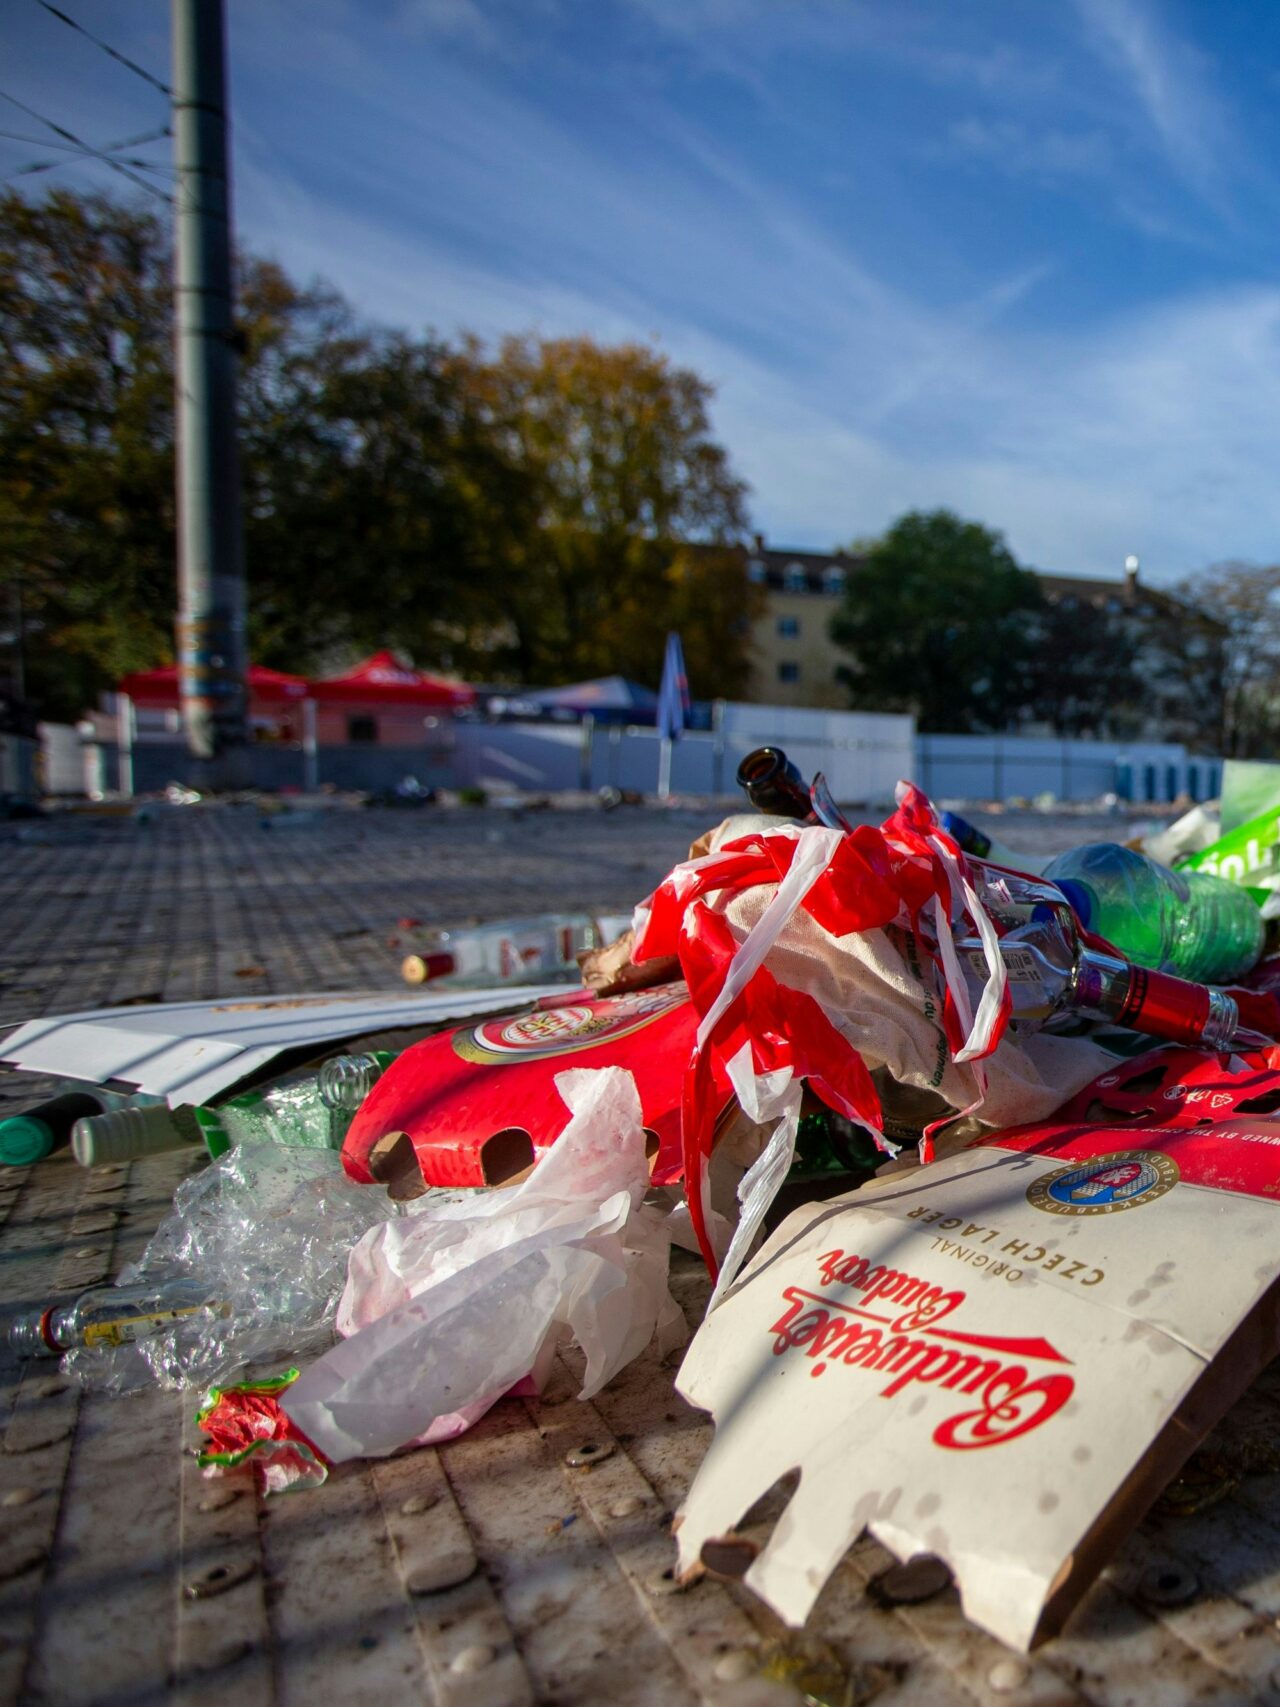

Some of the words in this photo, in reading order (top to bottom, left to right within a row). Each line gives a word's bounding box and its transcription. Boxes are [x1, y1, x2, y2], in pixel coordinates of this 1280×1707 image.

[1187, 1128, 1214, 1137] THE
[1215, 1131, 1239, 1140] BY
[904, 1204, 1001, 1245] LAGER
[930, 1235, 1025, 1283] ORIGINAL
[999, 1238, 1106, 1288] CZECH
[815, 1249, 967, 1334] Budvar
[768, 1287, 1076, 1452] Budweiser
